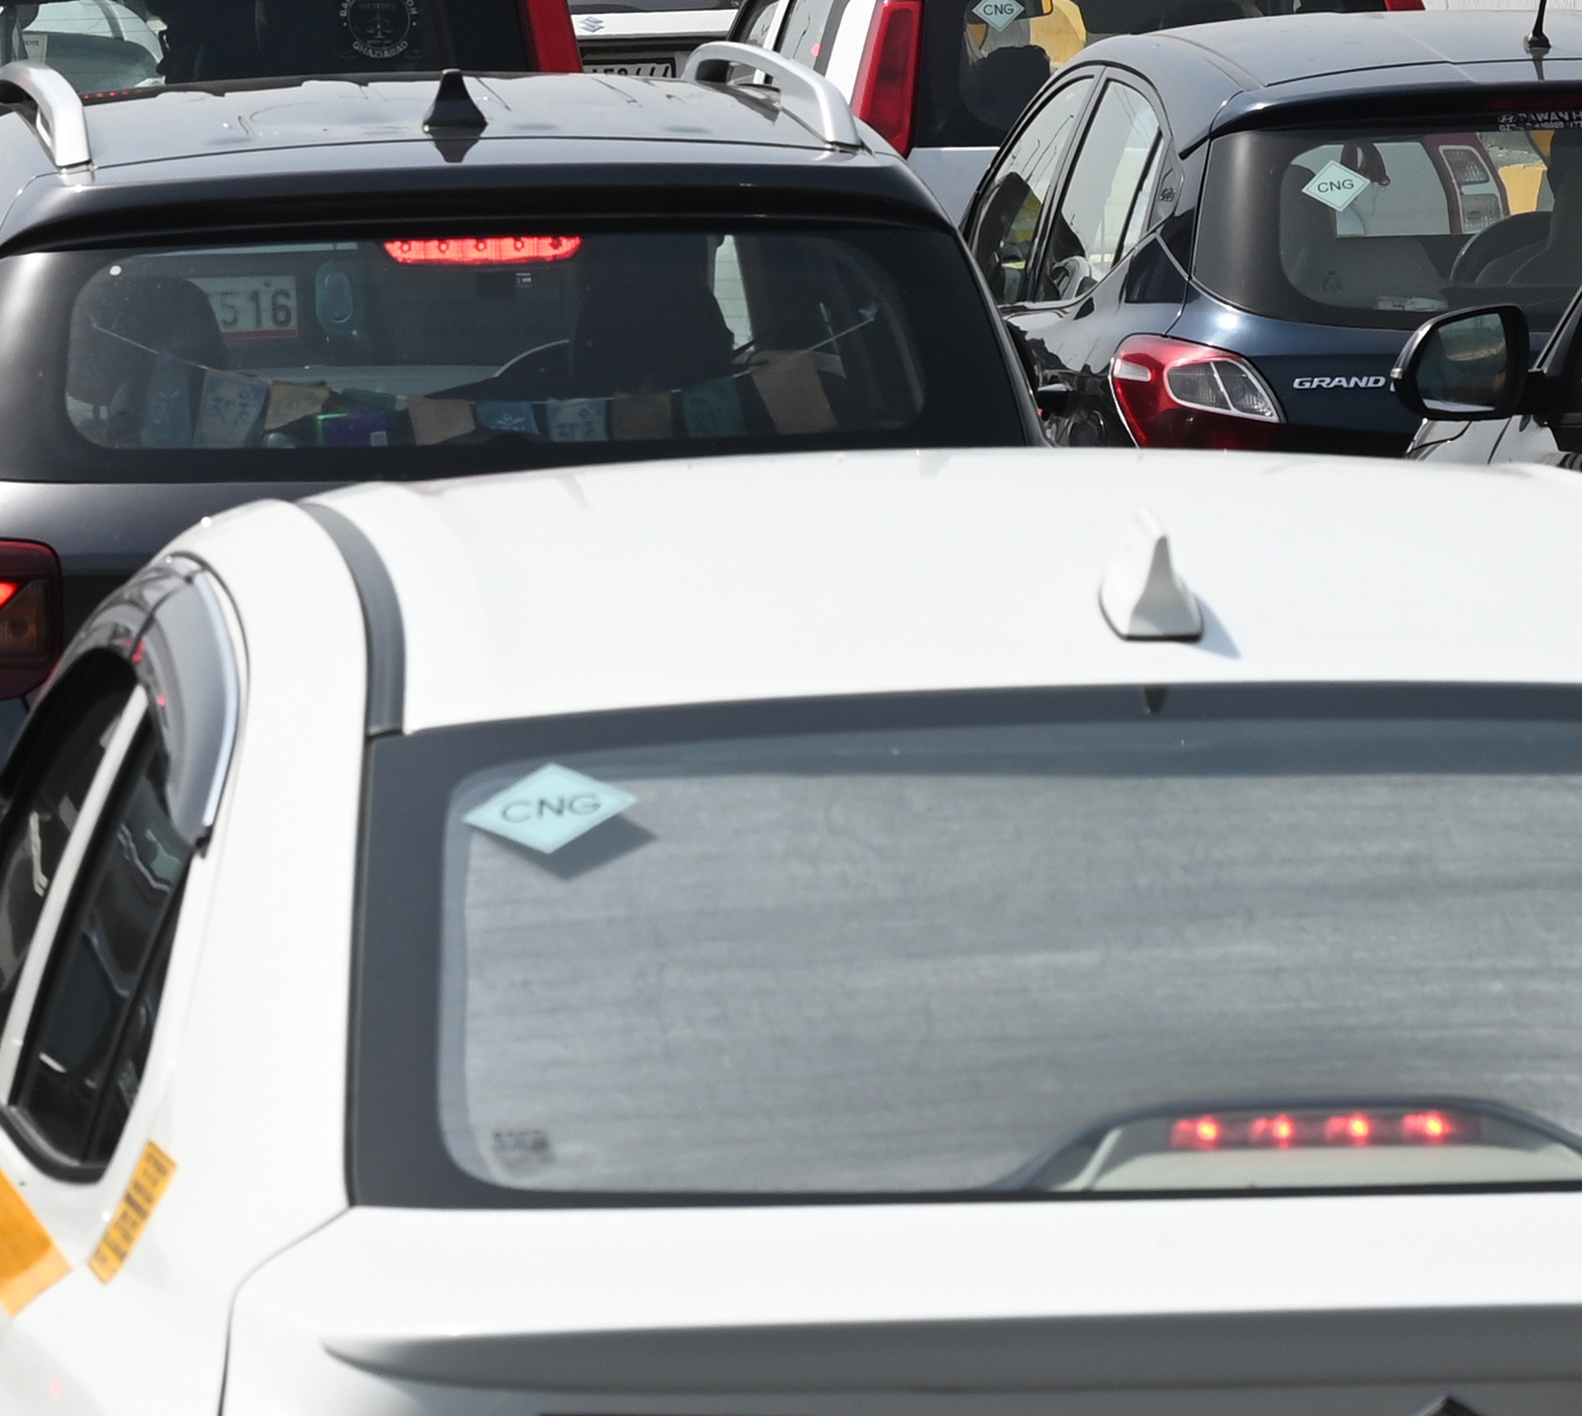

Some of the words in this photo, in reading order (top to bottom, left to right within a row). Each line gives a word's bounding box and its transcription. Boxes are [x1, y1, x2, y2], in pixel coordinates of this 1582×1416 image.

[983, 3, 1015, 15] CNG
[1317, 179, 1355, 193] CNG
[1293, 376, 1386, 389] GRAND
[501, 792, 602, 823] CNG
